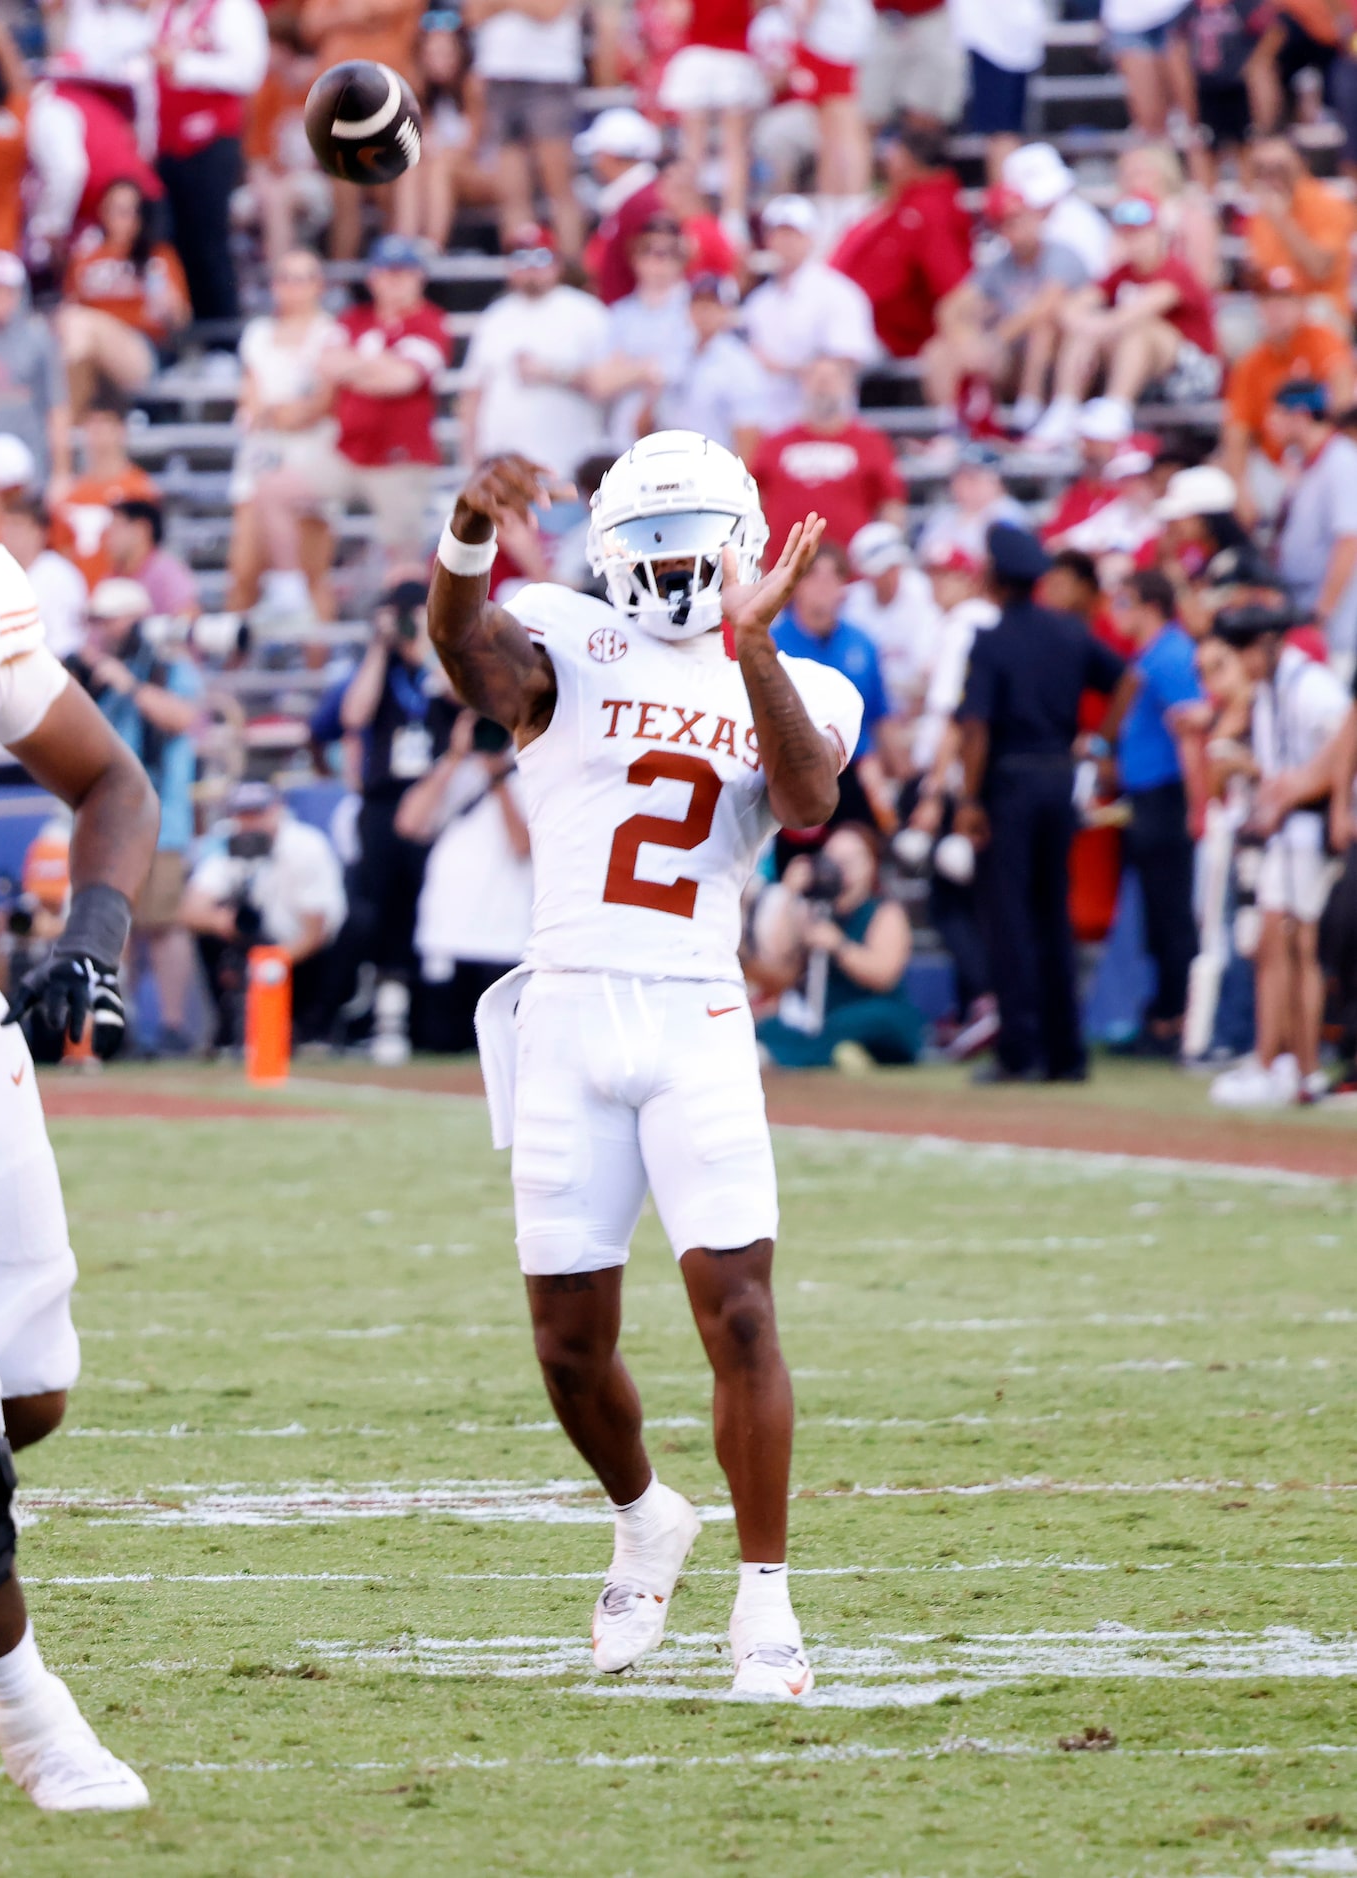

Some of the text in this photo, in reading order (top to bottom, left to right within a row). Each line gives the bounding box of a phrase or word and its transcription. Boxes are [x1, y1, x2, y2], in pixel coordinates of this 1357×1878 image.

[588, 628, 628, 663] SEC
[600, 699, 763, 772] TEXAS
[603, 749, 723, 919] 2
